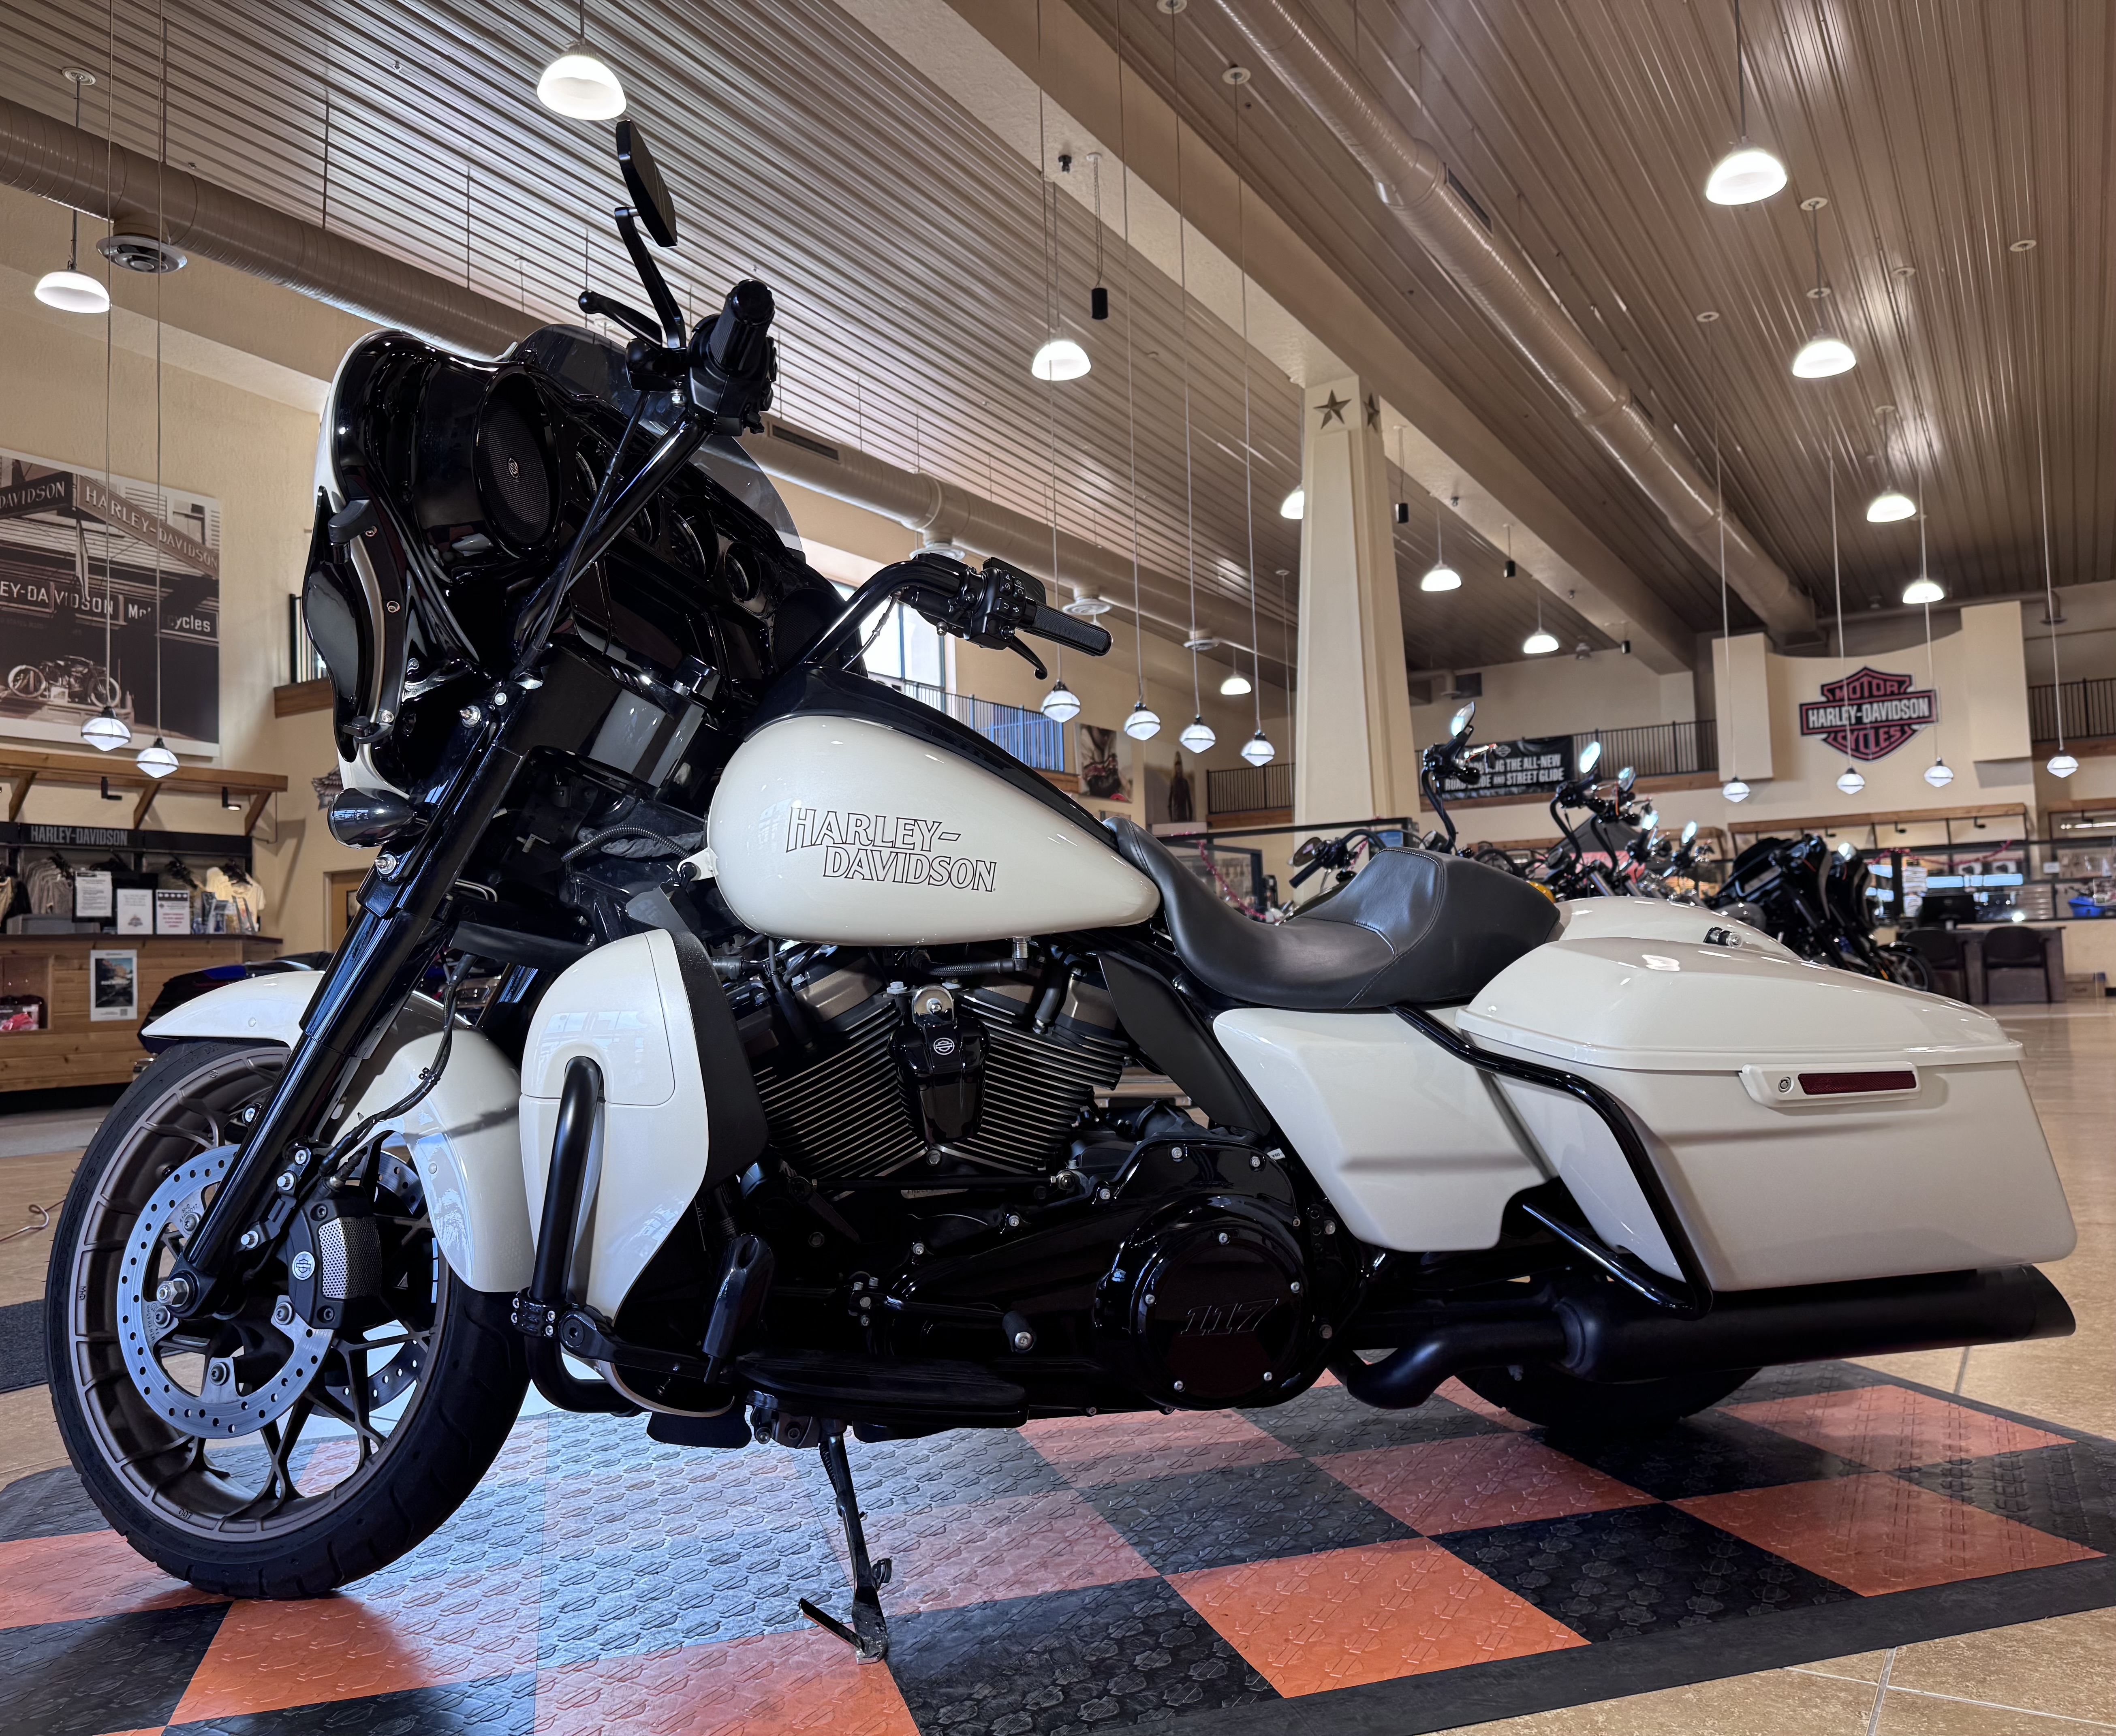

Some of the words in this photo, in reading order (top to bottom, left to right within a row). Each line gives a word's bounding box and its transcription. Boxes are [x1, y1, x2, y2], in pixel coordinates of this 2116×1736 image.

[0, 481, 64, 509] DAVIDSON
[85, 486, 218, 567] HARLEY-DAVIDSON
[1835, 676, 1899, 701] MOTOR
[1808, 697, 1929, 729] HARLEY-DAVIDSON
[1837, 726, 1902, 755] CYCLES
[1506, 757, 1522, 771] THE
[1523, 753, 1561, 770] ALL-NEW
[1506, 771, 1538, 785] STREET
[1539, 768, 1565, 782] GLIDE
[31, 825, 128, 846] HARLEY-DAVIDSON
[786, 807, 961, 853] HARLEY-
[823, 846, 996, 892] DAVIDSON
[1178, 1298, 1279, 1336] 117
[179, 1508, 193, 1519] DOT
